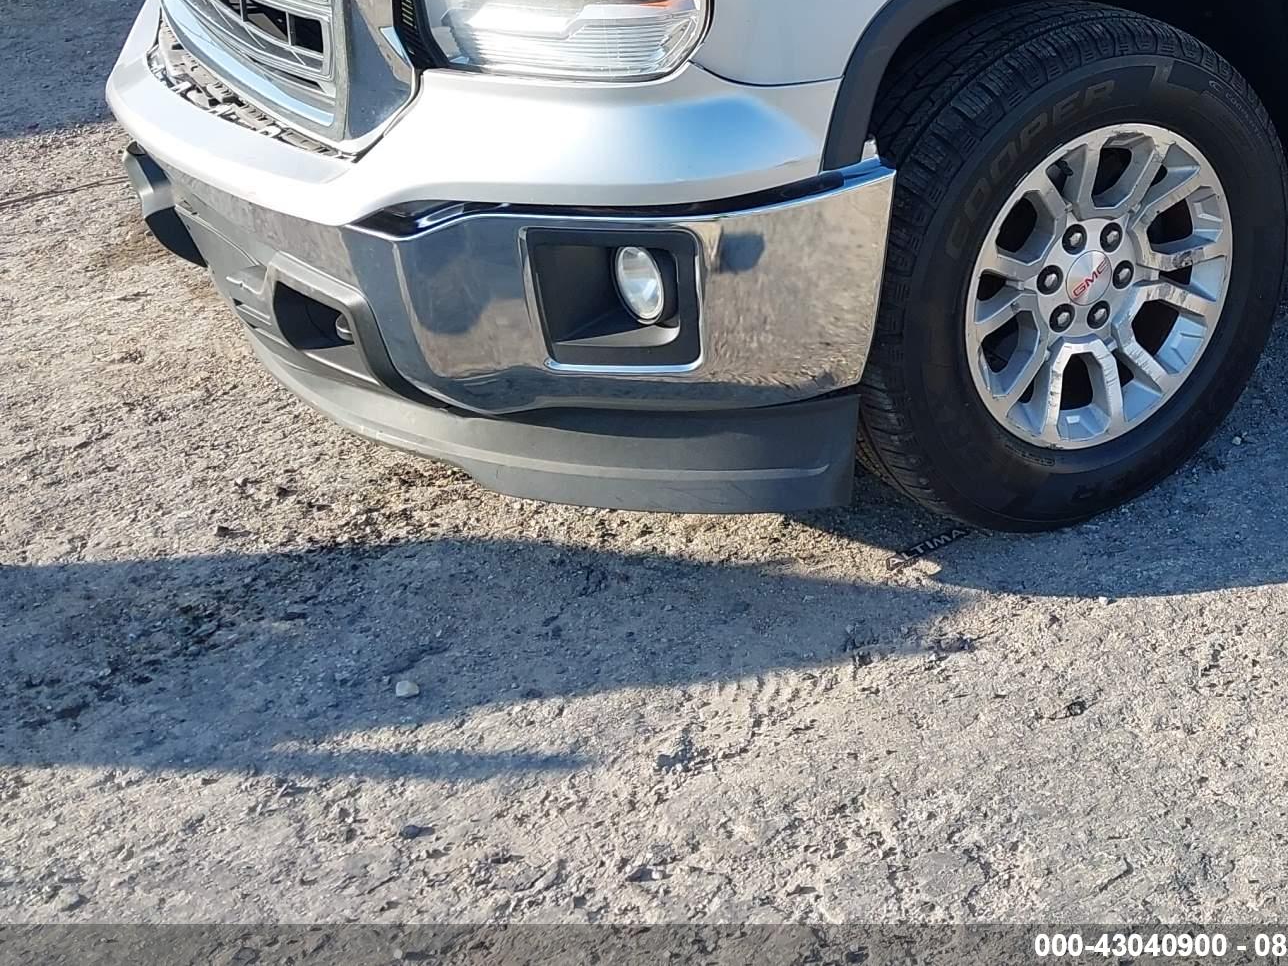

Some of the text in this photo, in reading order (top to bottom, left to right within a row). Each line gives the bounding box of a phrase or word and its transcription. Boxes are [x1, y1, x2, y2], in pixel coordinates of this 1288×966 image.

[944, 78, 1118, 260] COOPER
[1072, 256, 1109, 300] GMC
[887, 528, 966, 569] ALTIMA
